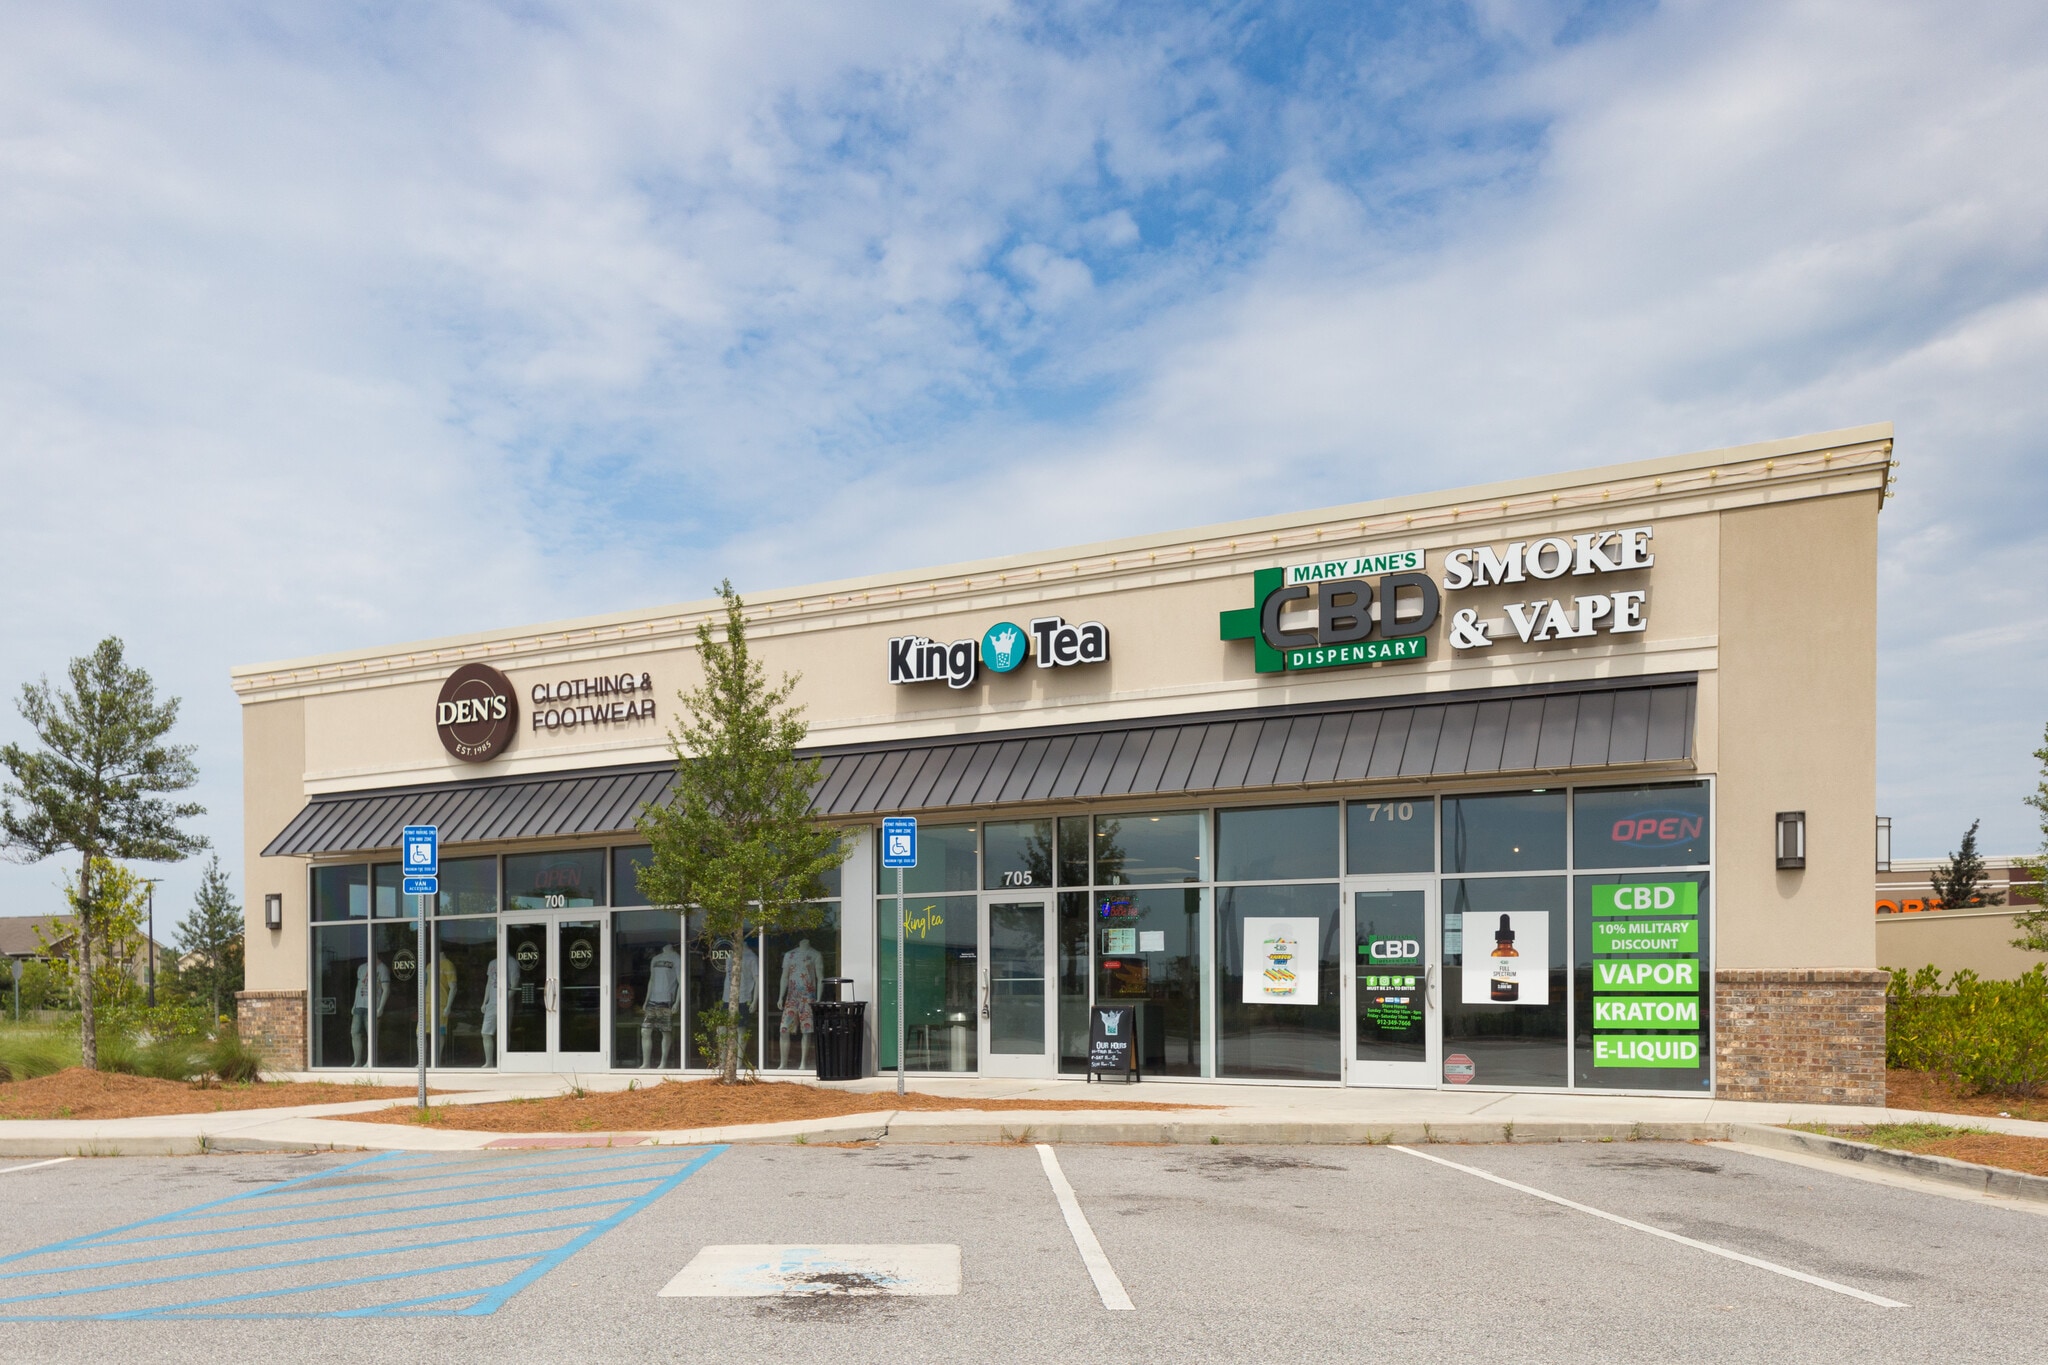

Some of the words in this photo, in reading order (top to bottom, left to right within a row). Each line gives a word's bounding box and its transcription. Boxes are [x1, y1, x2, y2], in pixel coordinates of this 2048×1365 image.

[1294, 561, 1348, 582] MARY
[1353, 552, 1417, 575] JANE'S
[1443, 526, 1655, 590] SMOKE
[1262, 572, 1440, 647] CBD
[1449, 608, 1492, 649] &
[1503, 590, 1648, 643] VAPE
[889, 637, 975, 688] King
[1032, 618, 1105, 667] Tea
[1293, 640, 1419, 666] DISPENSARY
[531, 673, 635, 704] CLOTHING
[640, 672, 652, 691] &
[438, 695, 507, 726] DEN'S
[532, 699, 656, 731] FOOTWEAR
[474, 740, 491, 755] 1985
[1366, 802, 1413, 822] 710
[1611, 816, 1703, 842] OPEN
[535, 867, 581, 889] OPEN
[1004, 871, 1032, 886] 705
[545, 894, 565, 908] 700
[1613, 887, 1675, 909] CBD
[903, 909, 926, 939] King
[923, 905, 944, 930] Tea
[1598, 923, 1626, 935] 10%
[1629, 922, 1689, 934] MILITARY
[571, 950, 592, 959] DEN'S
[712, 950, 734, 960] DEN'
[1371, 940, 1420, 958] CBD
[1611, 939, 1679, 950] DISCOUNT
[394, 960, 415, 970] DEN'S
[517, 951, 538, 960] DEN'S
[1599, 963, 1692, 984] VAPOR
[1595, 1002, 1697, 1021] KRATOM
[1096, 1041, 1109, 1049] OUR
[1596, 1041, 1697, 1062] E-LIQUID
